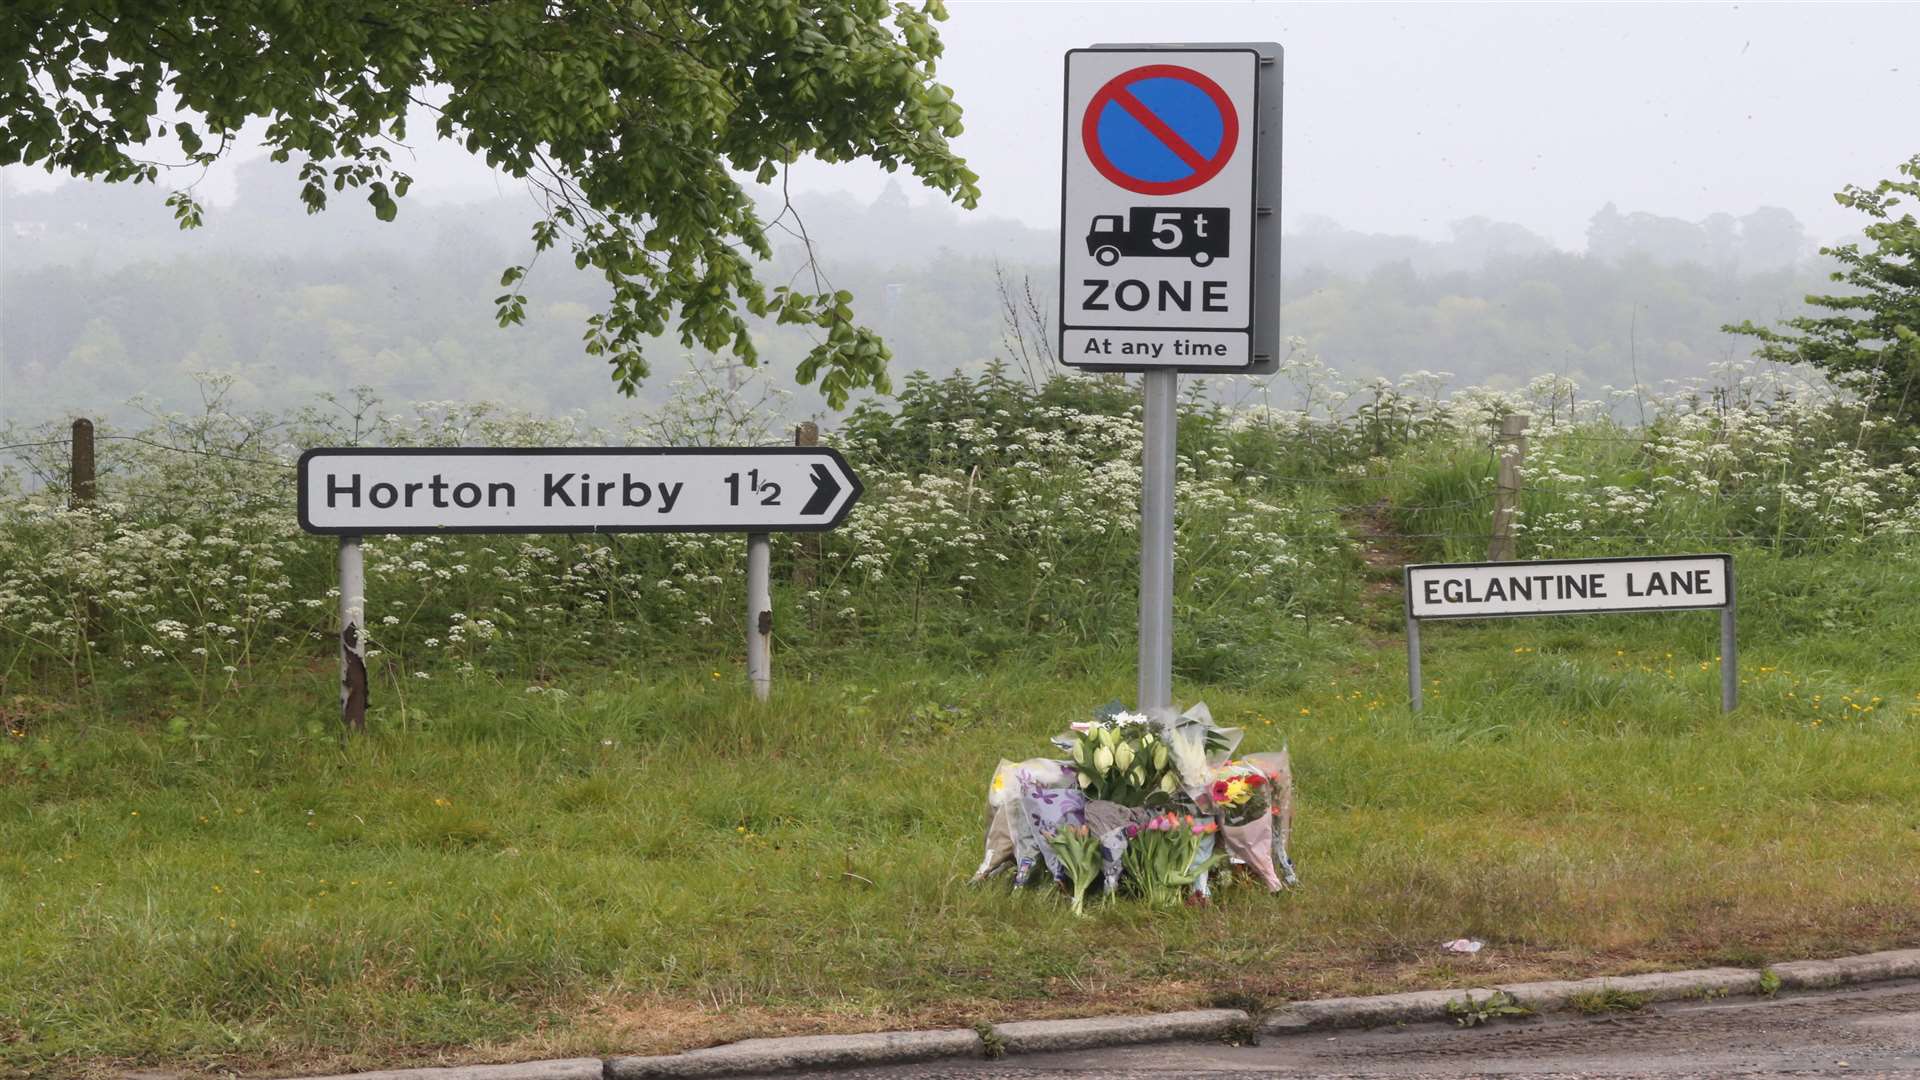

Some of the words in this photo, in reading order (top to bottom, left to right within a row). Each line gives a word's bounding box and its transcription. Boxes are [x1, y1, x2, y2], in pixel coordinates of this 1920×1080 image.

[1082, 279, 1229, 312] ZONE
[1084, 338, 1112, 355] At
[1121, 340, 1164, 358] any
[1174, 339, 1227, 356] time
[326, 473, 516, 508] Horton
[543, 473, 684, 514] Kirby
[1423, 573, 1607, 605] EGLANTINE
[1626, 569, 1713, 597] LANE
